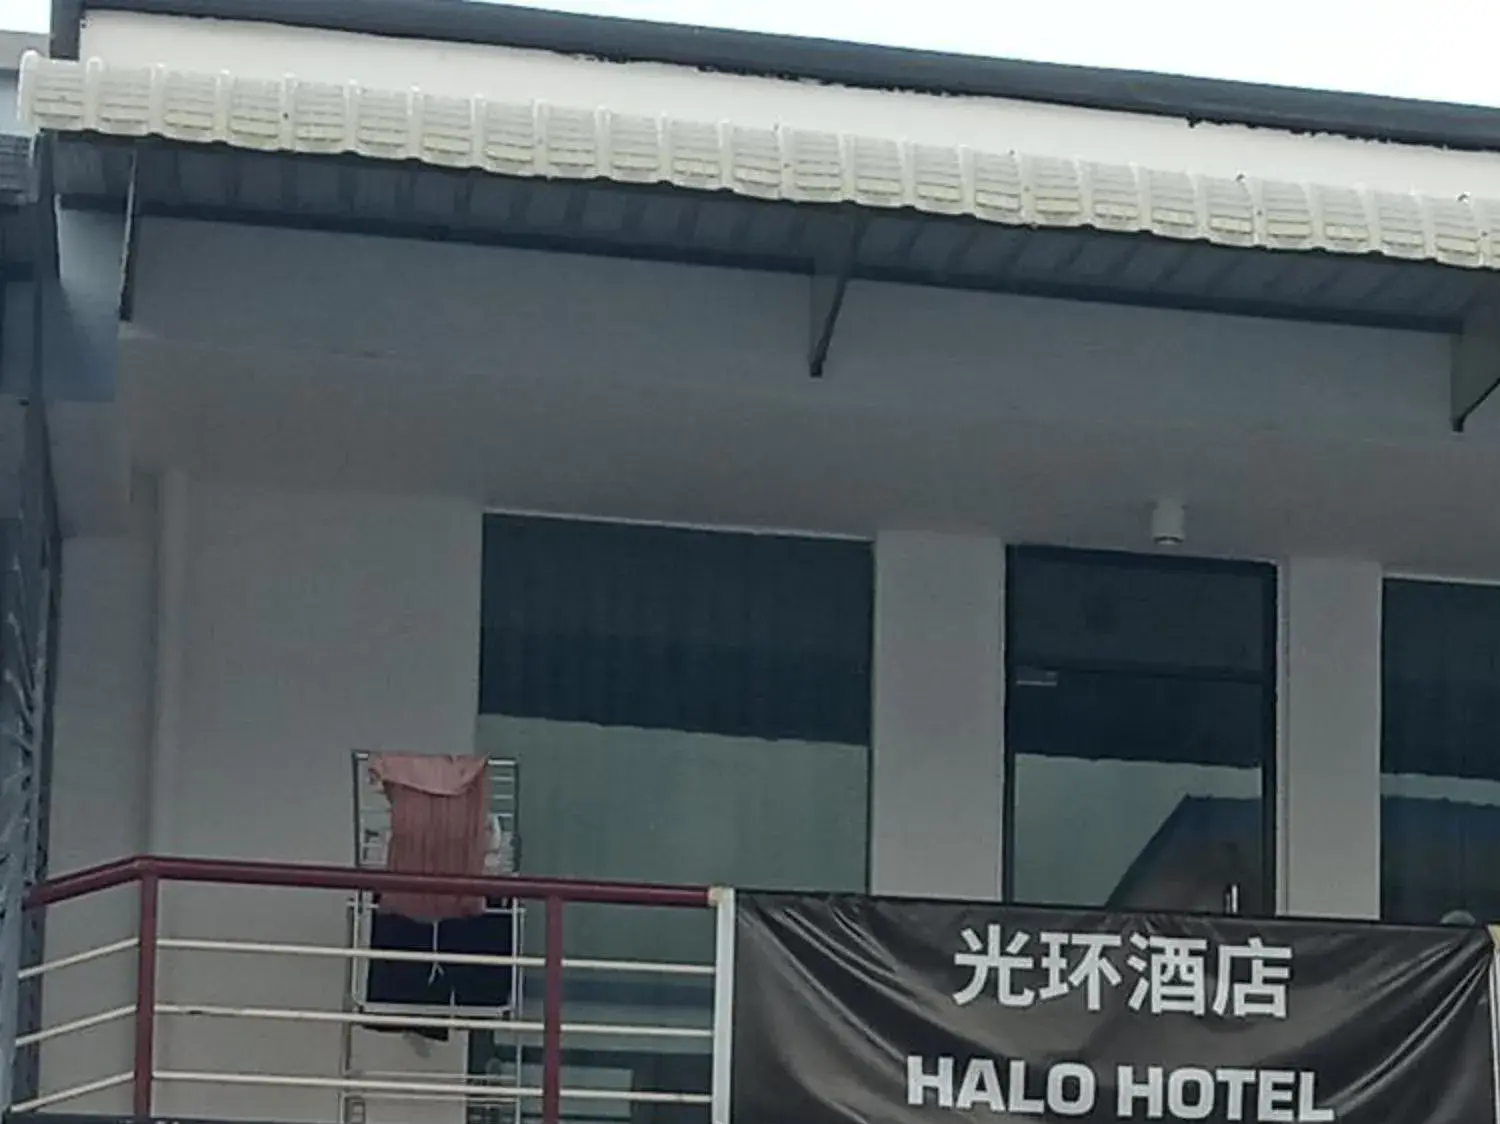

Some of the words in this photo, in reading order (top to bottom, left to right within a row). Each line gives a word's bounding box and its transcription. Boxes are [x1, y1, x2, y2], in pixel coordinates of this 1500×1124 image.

[954, 924, 1292, 1018] 光环酒店
[906, 1055, 1093, 1116] HALO
[1117, 1064, 1336, 1124] HOTEL
